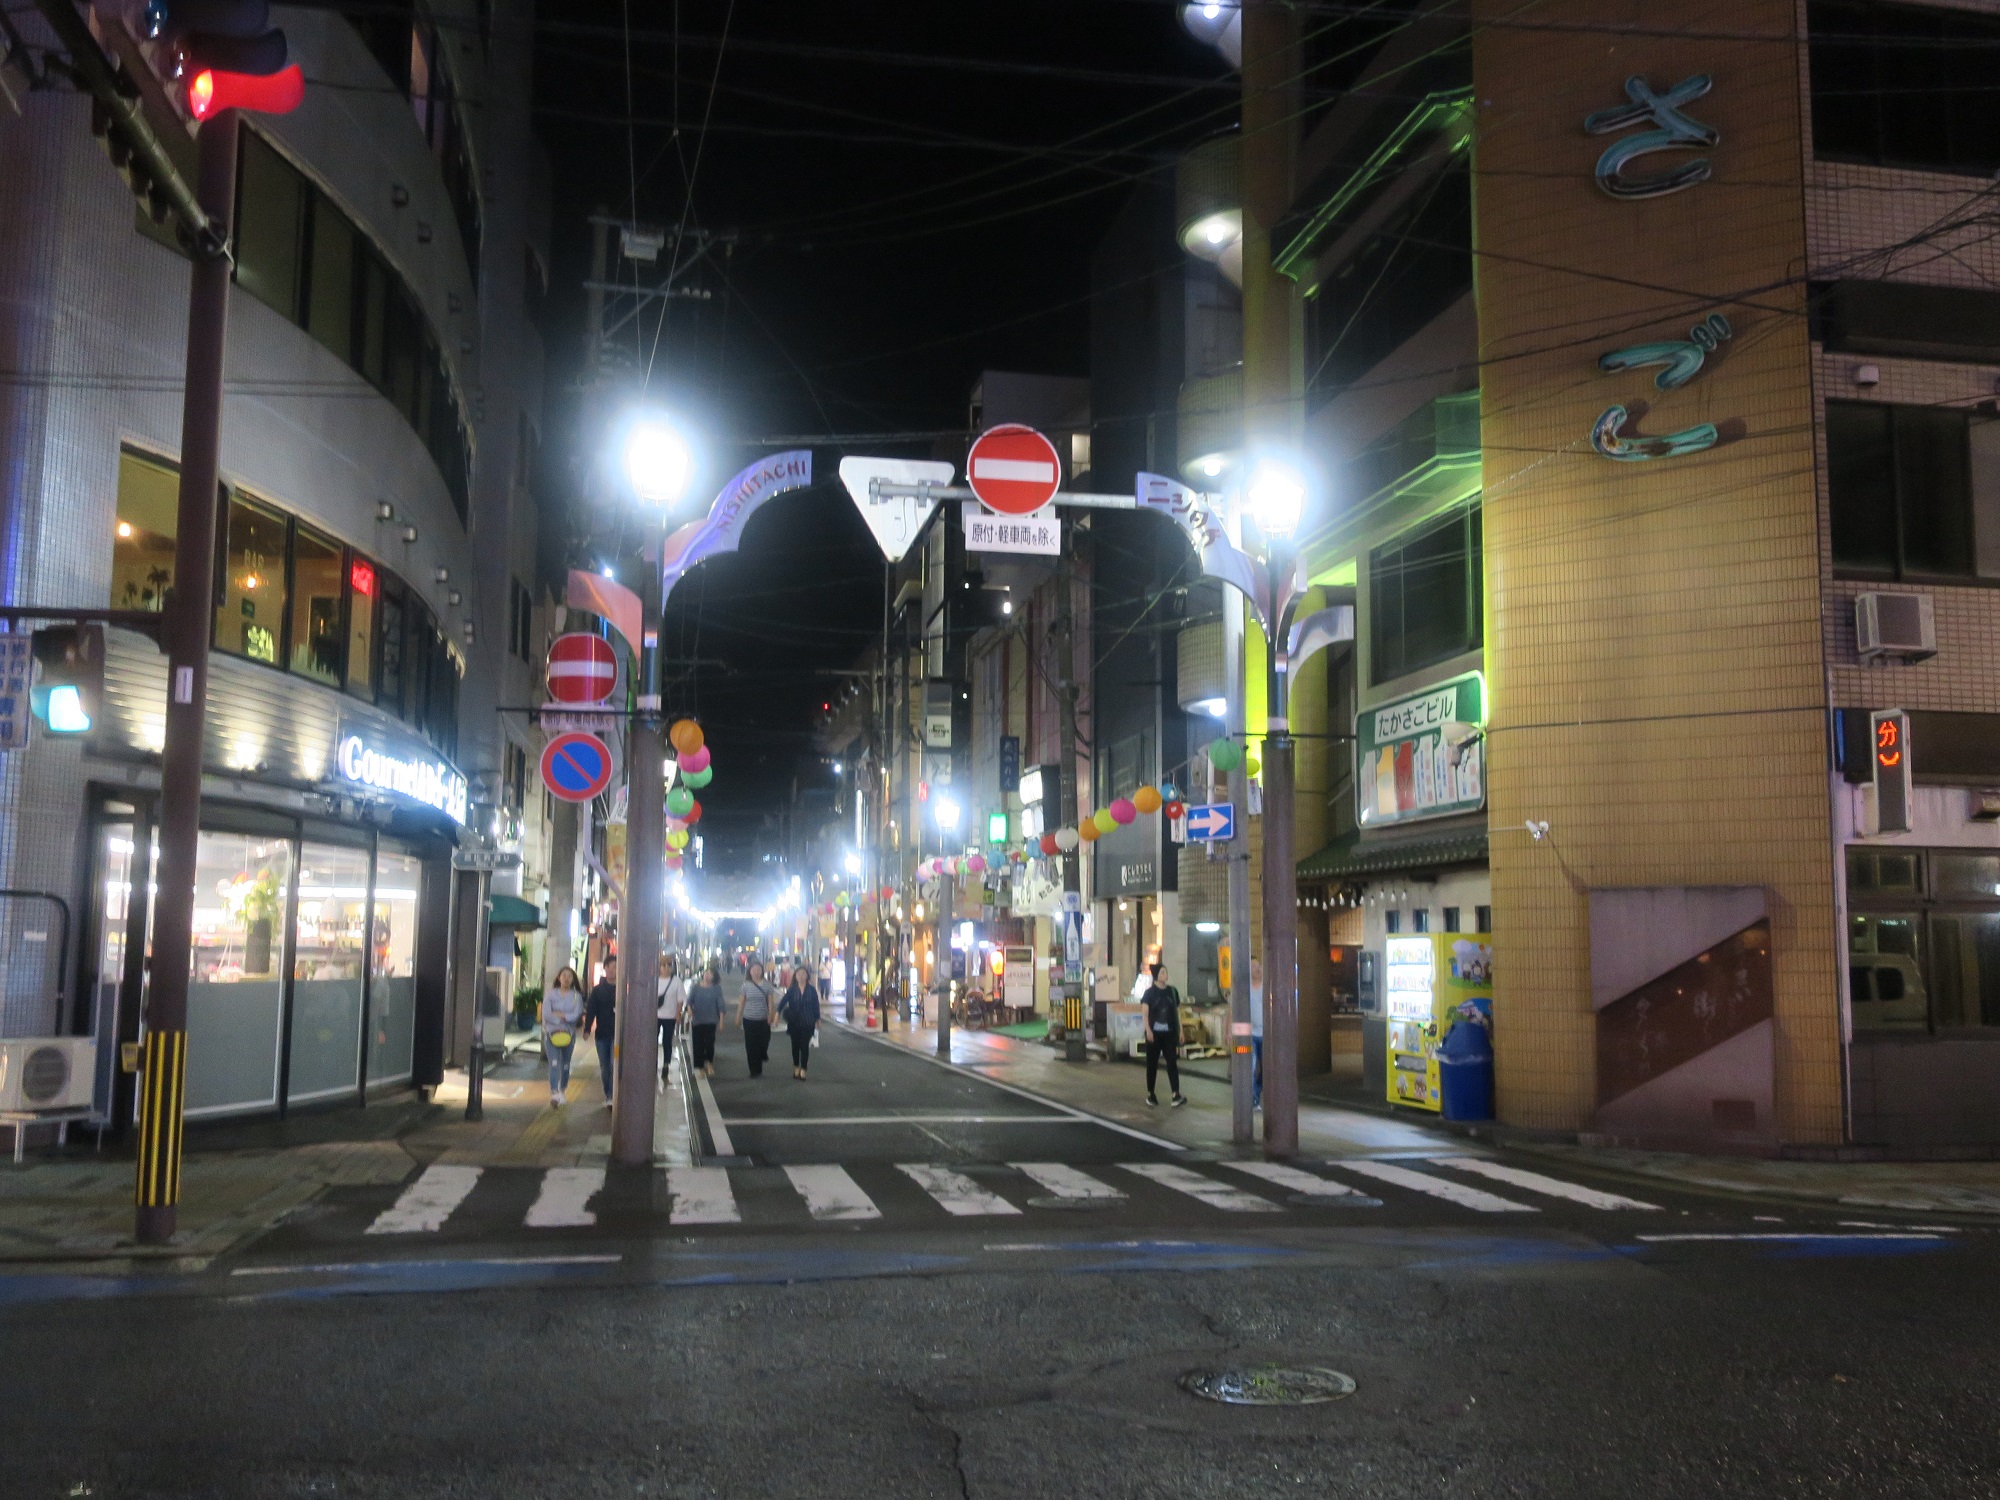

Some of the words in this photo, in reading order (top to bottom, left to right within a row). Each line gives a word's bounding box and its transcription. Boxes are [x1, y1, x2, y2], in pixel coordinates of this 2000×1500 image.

[717, 459, 806, 533] NISHITACHI
[1378, 695, 1453, 738] たかさごビル
